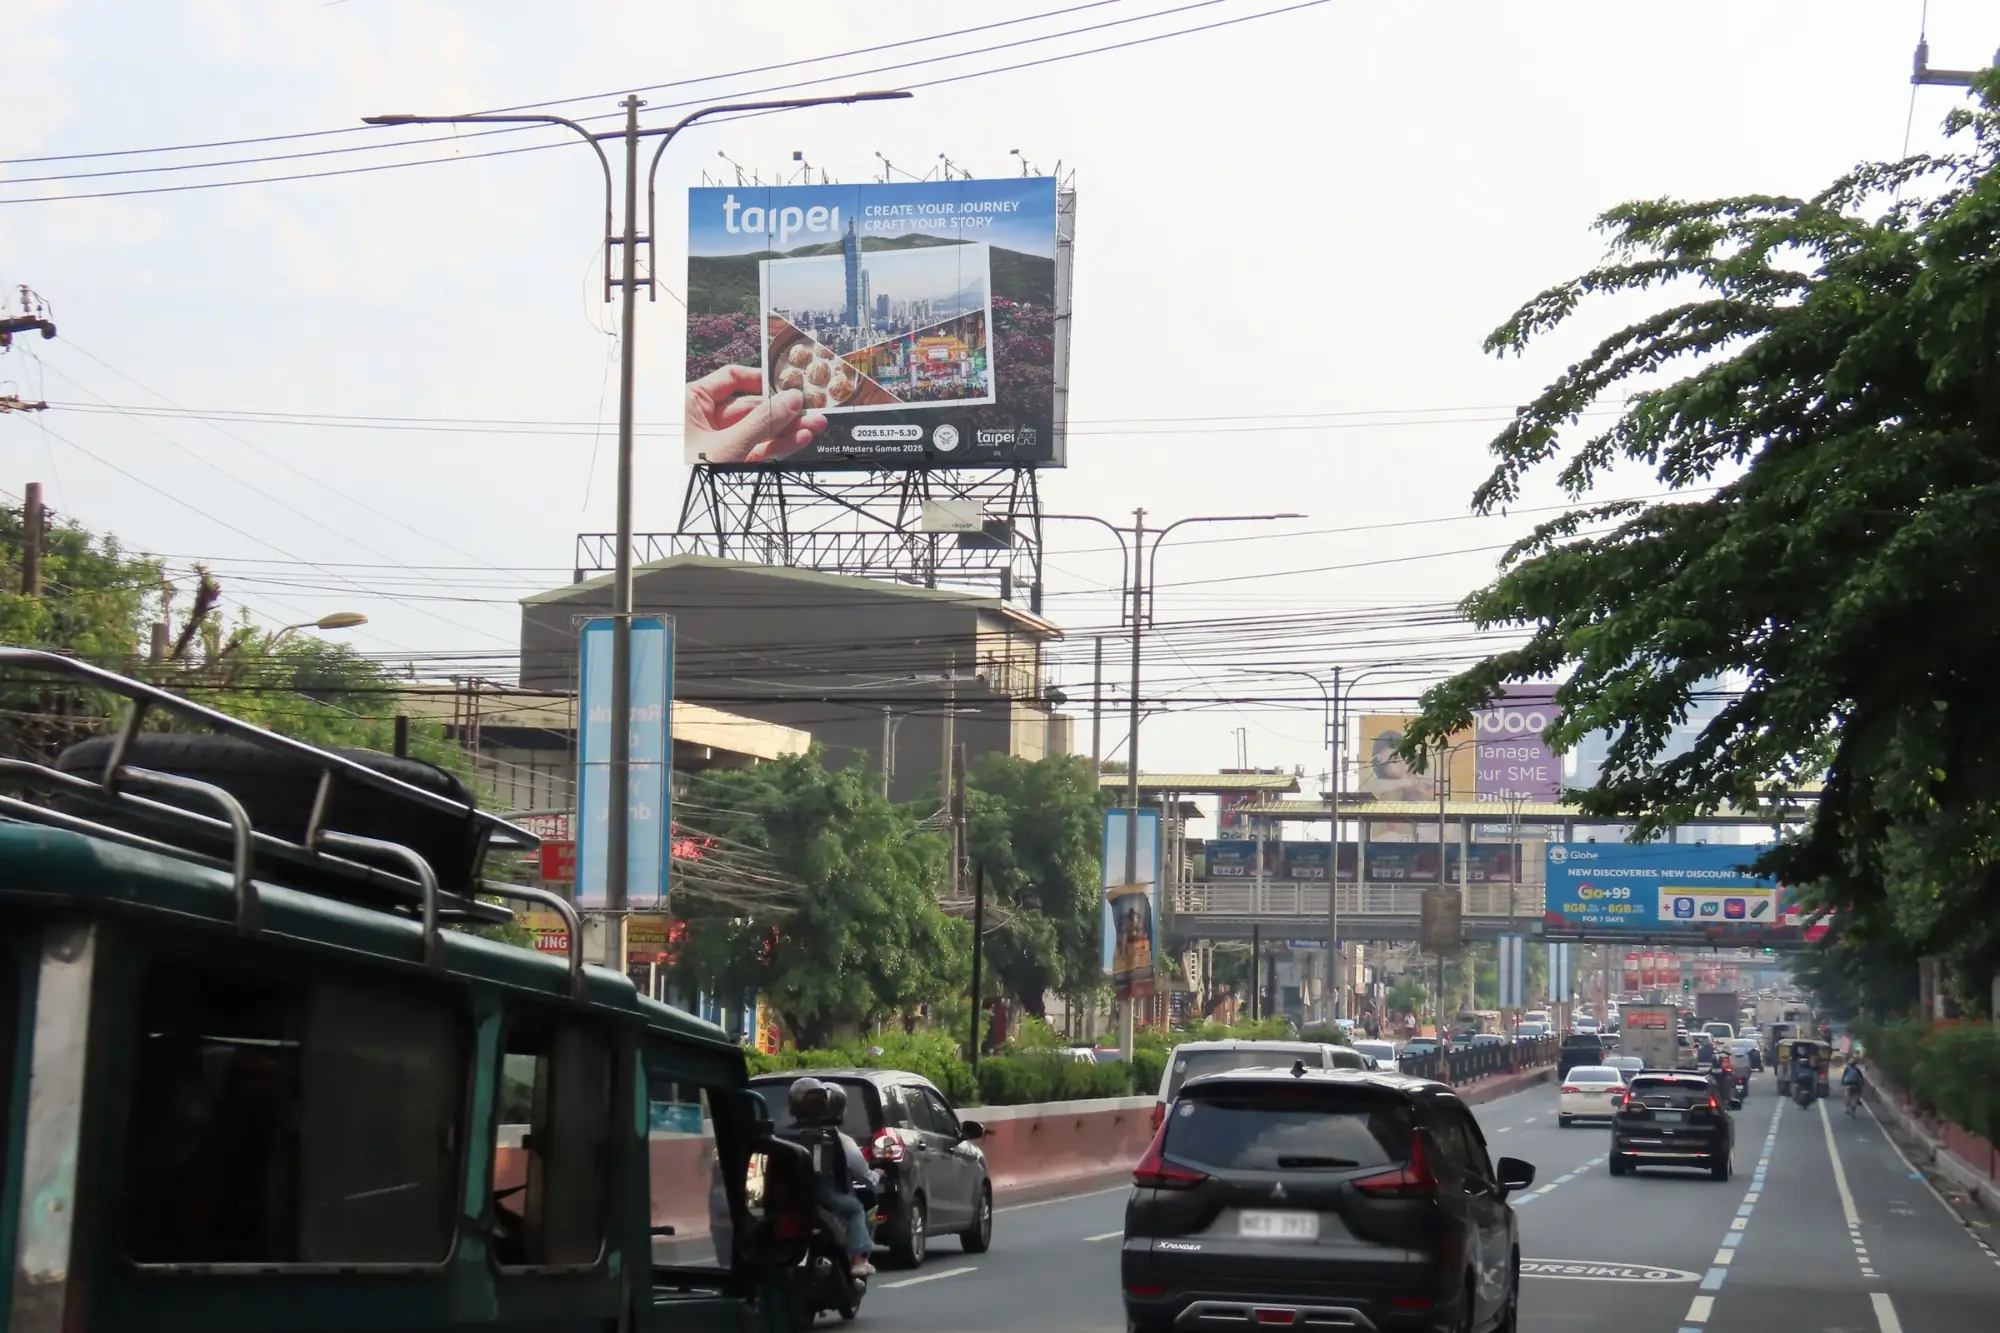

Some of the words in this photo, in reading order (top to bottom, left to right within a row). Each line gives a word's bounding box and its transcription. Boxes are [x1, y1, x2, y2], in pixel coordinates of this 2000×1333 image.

[865, 204, 913, 217] CREATE
[917, 203, 953, 215] YOUR
[957, 201, 1020, 213] JOURNEY
[723, 194, 839, 243] taipei
[864, 219, 908, 231] CRAFT
[910, 217, 947, 230] YOUR
[950, 216, 994, 229] STORY
[976, 429, 1015, 446] taipei
[817, 445, 840, 453] World
[842, 445, 874, 453] Masters
[875, 445, 901, 453] Games
[902, 444, 923, 452] 2025
[1478, 769, 1501, 781] ur
[1508, 766, 1548, 781] SME
[1570, 851, 1599, 860] Globe
[1568, 868, 1592, 877] NEW
[1593, 869, 1660, 877] DISCOVERIES.
[1661, 870, 1684, 878] NEW
[1687, 870, 1737, 878] DISCOUNT
[532, 935, 568, 950] TING
[1158, 1242, 1202, 1251] XPANDER
[1519, 1263, 1668, 1279] ORSIKLO
